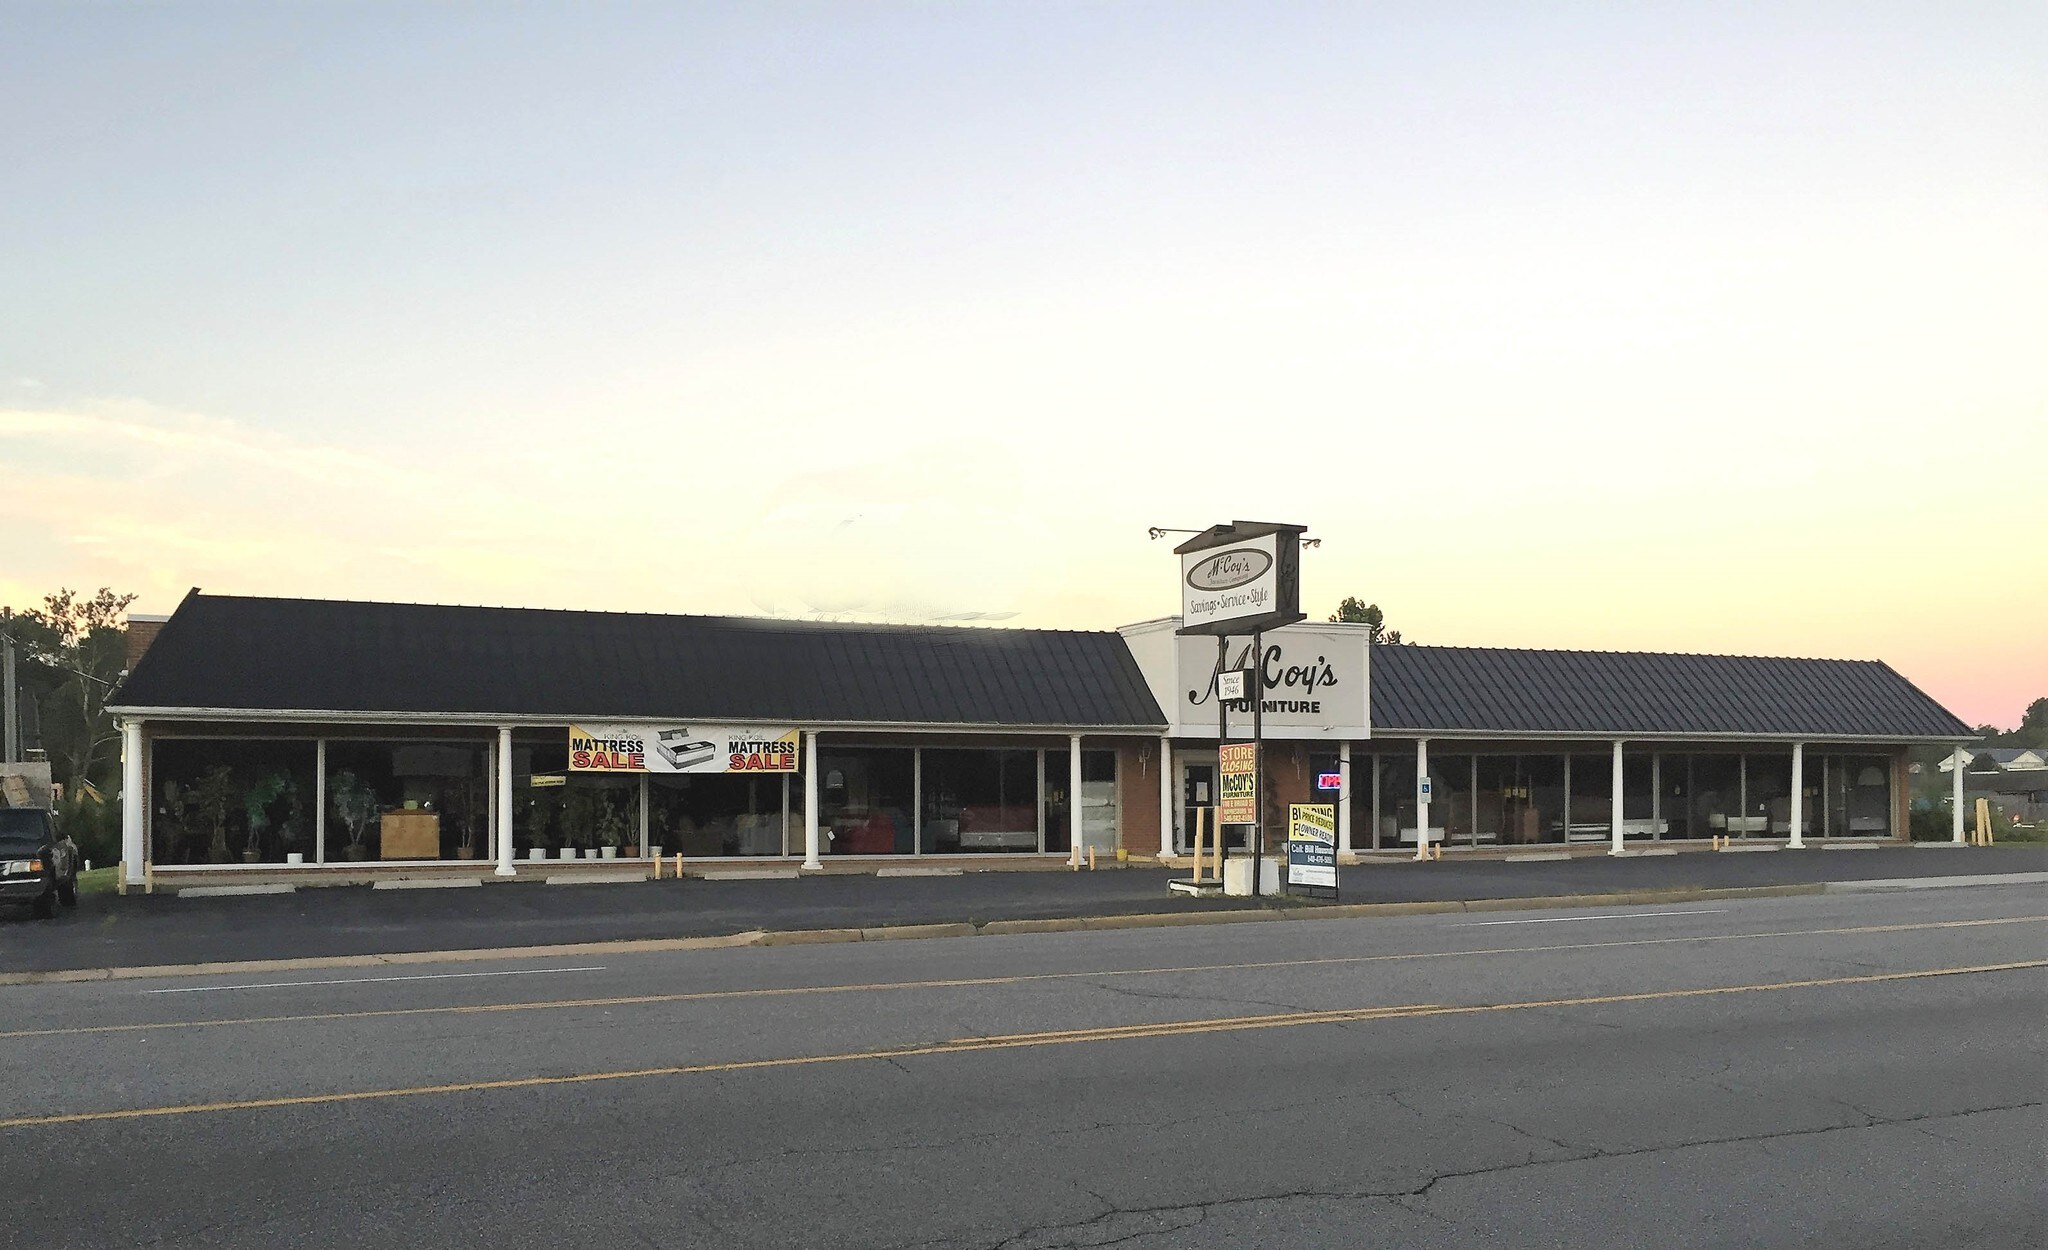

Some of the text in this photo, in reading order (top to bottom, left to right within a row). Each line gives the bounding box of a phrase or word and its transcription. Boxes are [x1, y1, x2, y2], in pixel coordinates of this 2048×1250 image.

[1207, 555, 1250, 578] McCoy's
[1190, 587, 1268, 615] Savings Service Style
[1189, 639, 1338, 705] MCoy's
[1224, 685, 1239, 696] 1946
[1228, 701, 1320, 713] FUNITURE
[572, 738, 644, 752] MATTRESS
[728, 741, 795, 754] MATTRESS
[573, 751, 645, 769] SALE
[1221, 747, 1253, 761] STORE
[729, 753, 795, 770] SALE
[1221, 760, 1253, 773] CLOSING
[1223, 773, 1254, 791] McCOY'S
[1302, 811, 1315, 823] PRICE
[1301, 824, 1318, 837] OWNER
